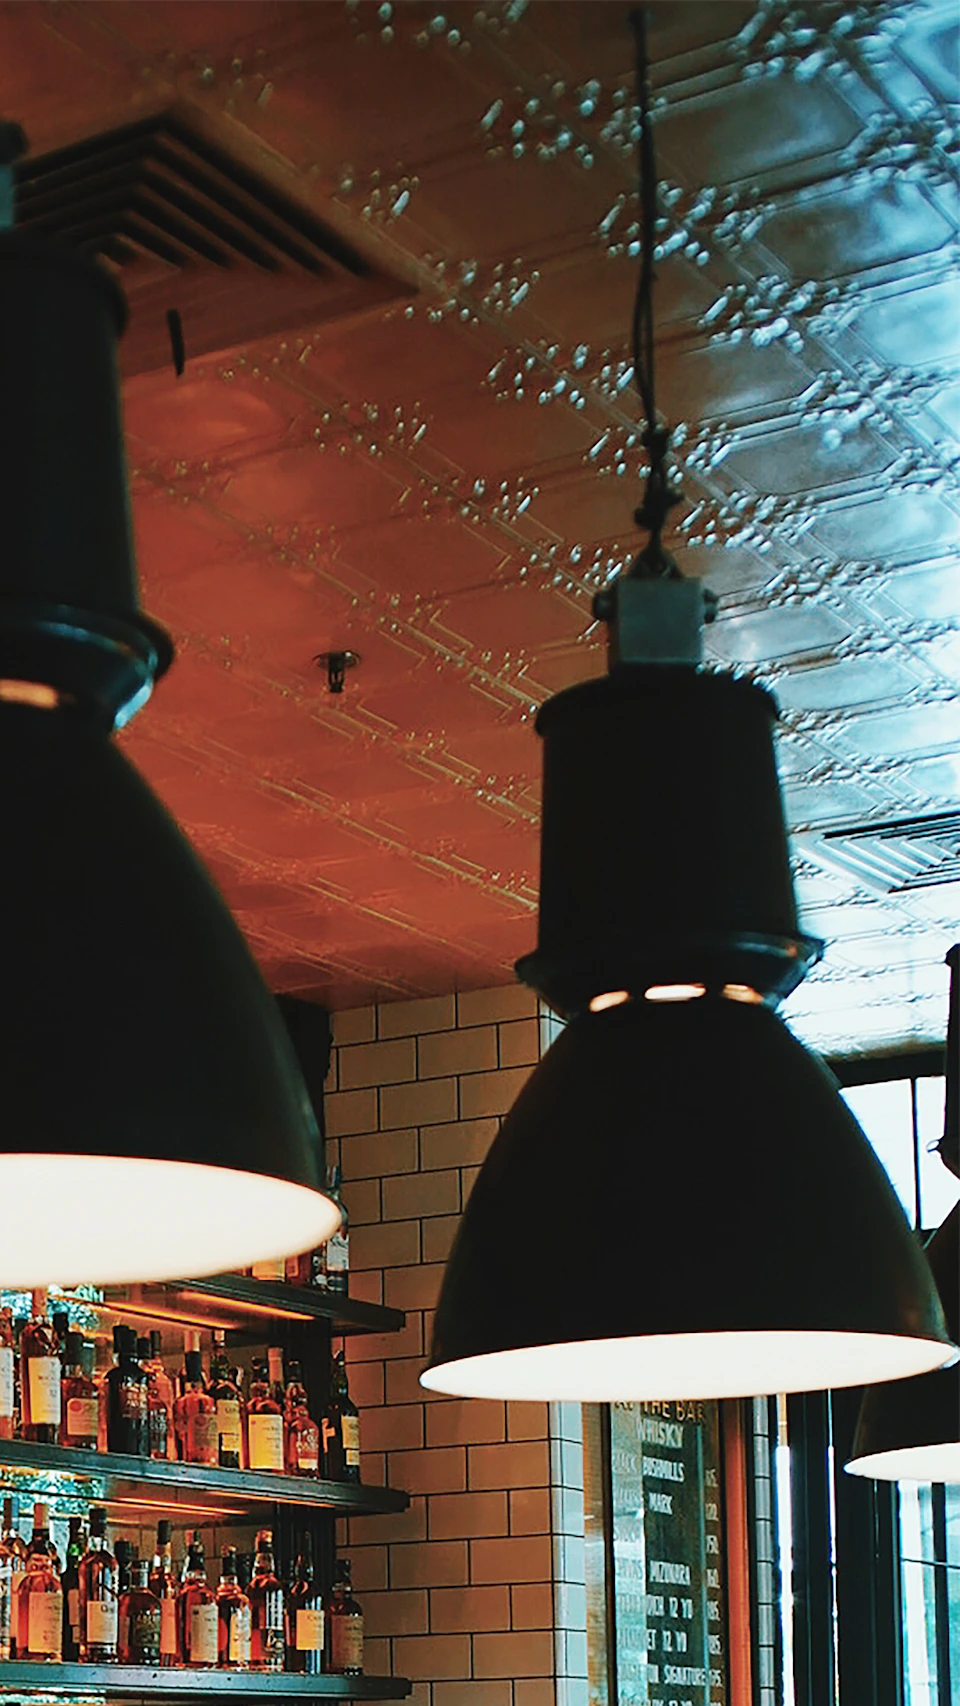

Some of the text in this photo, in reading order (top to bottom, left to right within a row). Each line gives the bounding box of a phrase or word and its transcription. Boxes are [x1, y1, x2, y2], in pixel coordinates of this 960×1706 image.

[636, 1418, 684, 1449] WHISKY
[642, 1456, 685, 1483] BUSHMILLS
[649, 1492, 673, 1516] MARK
